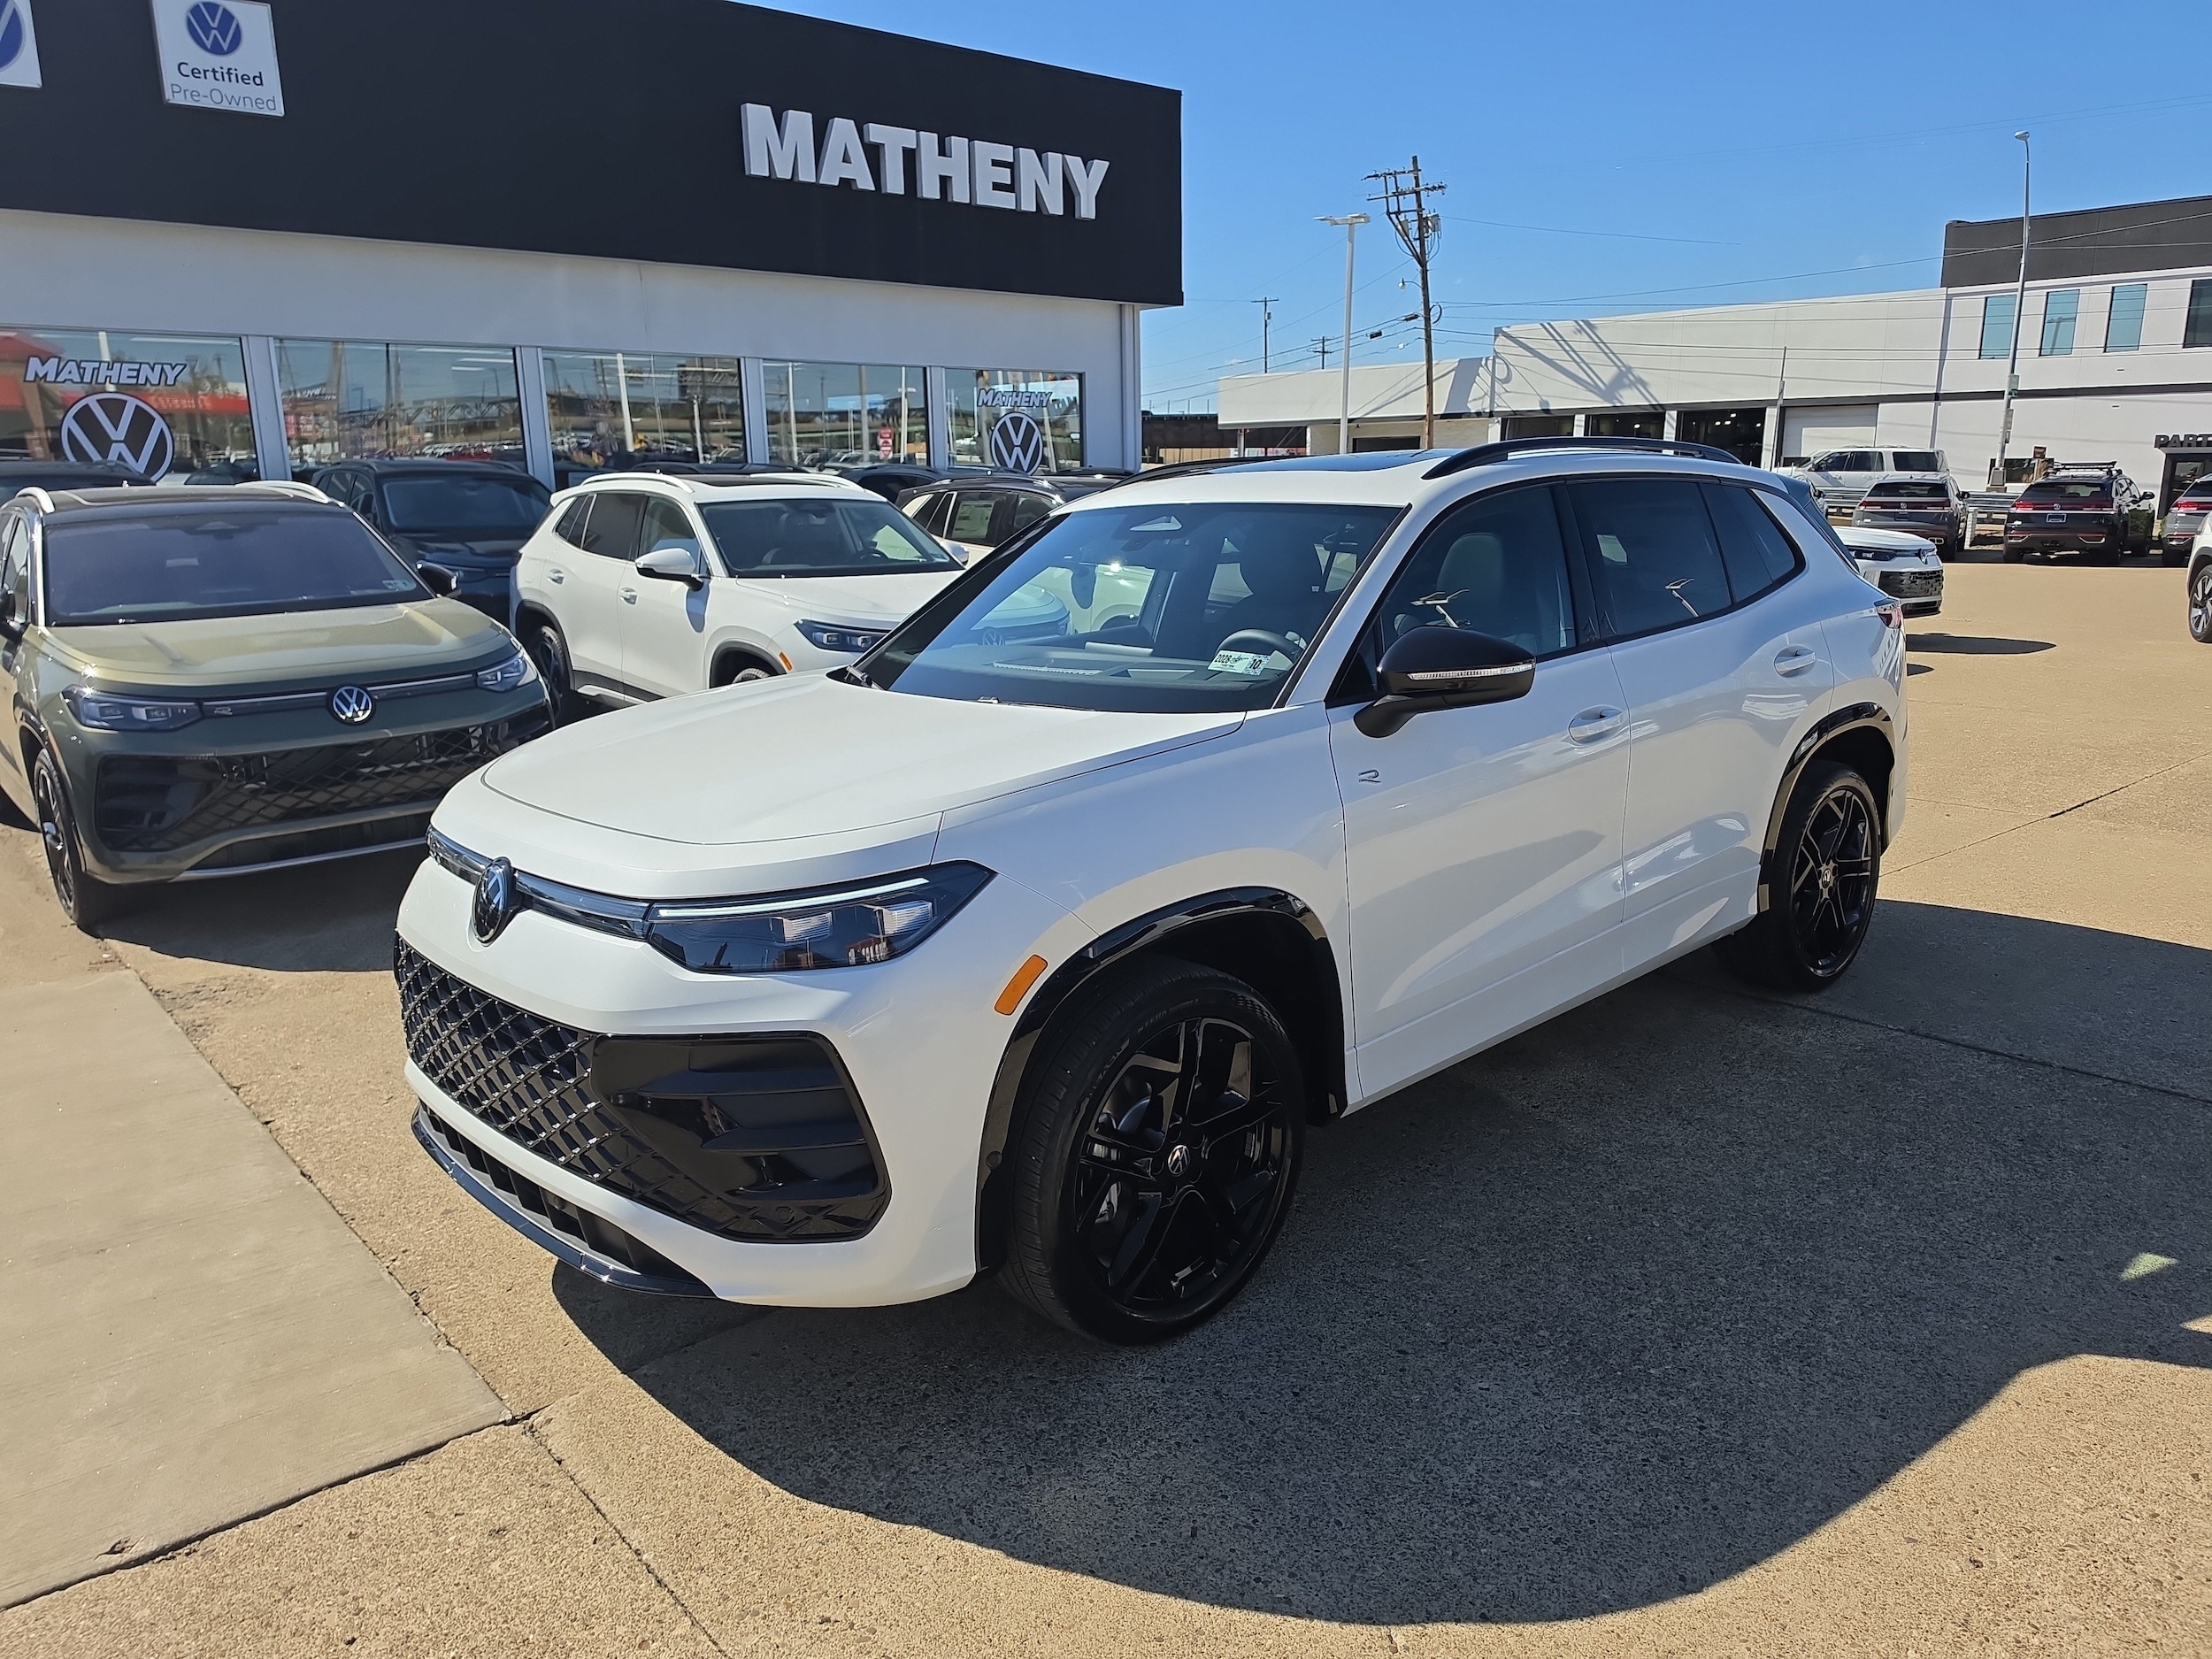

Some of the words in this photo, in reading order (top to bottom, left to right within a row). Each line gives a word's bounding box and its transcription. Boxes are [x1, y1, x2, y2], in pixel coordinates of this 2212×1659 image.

[177, 61, 264, 87] Certified
[170, 83, 277, 111] Pre-Owned
[741, 102, 1110, 221] MATHENY
[24, 356, 187, 387] MATHENY
[977, 388, 1053, 408] MATHENY
[1248, 658, 1263, 670] 10
